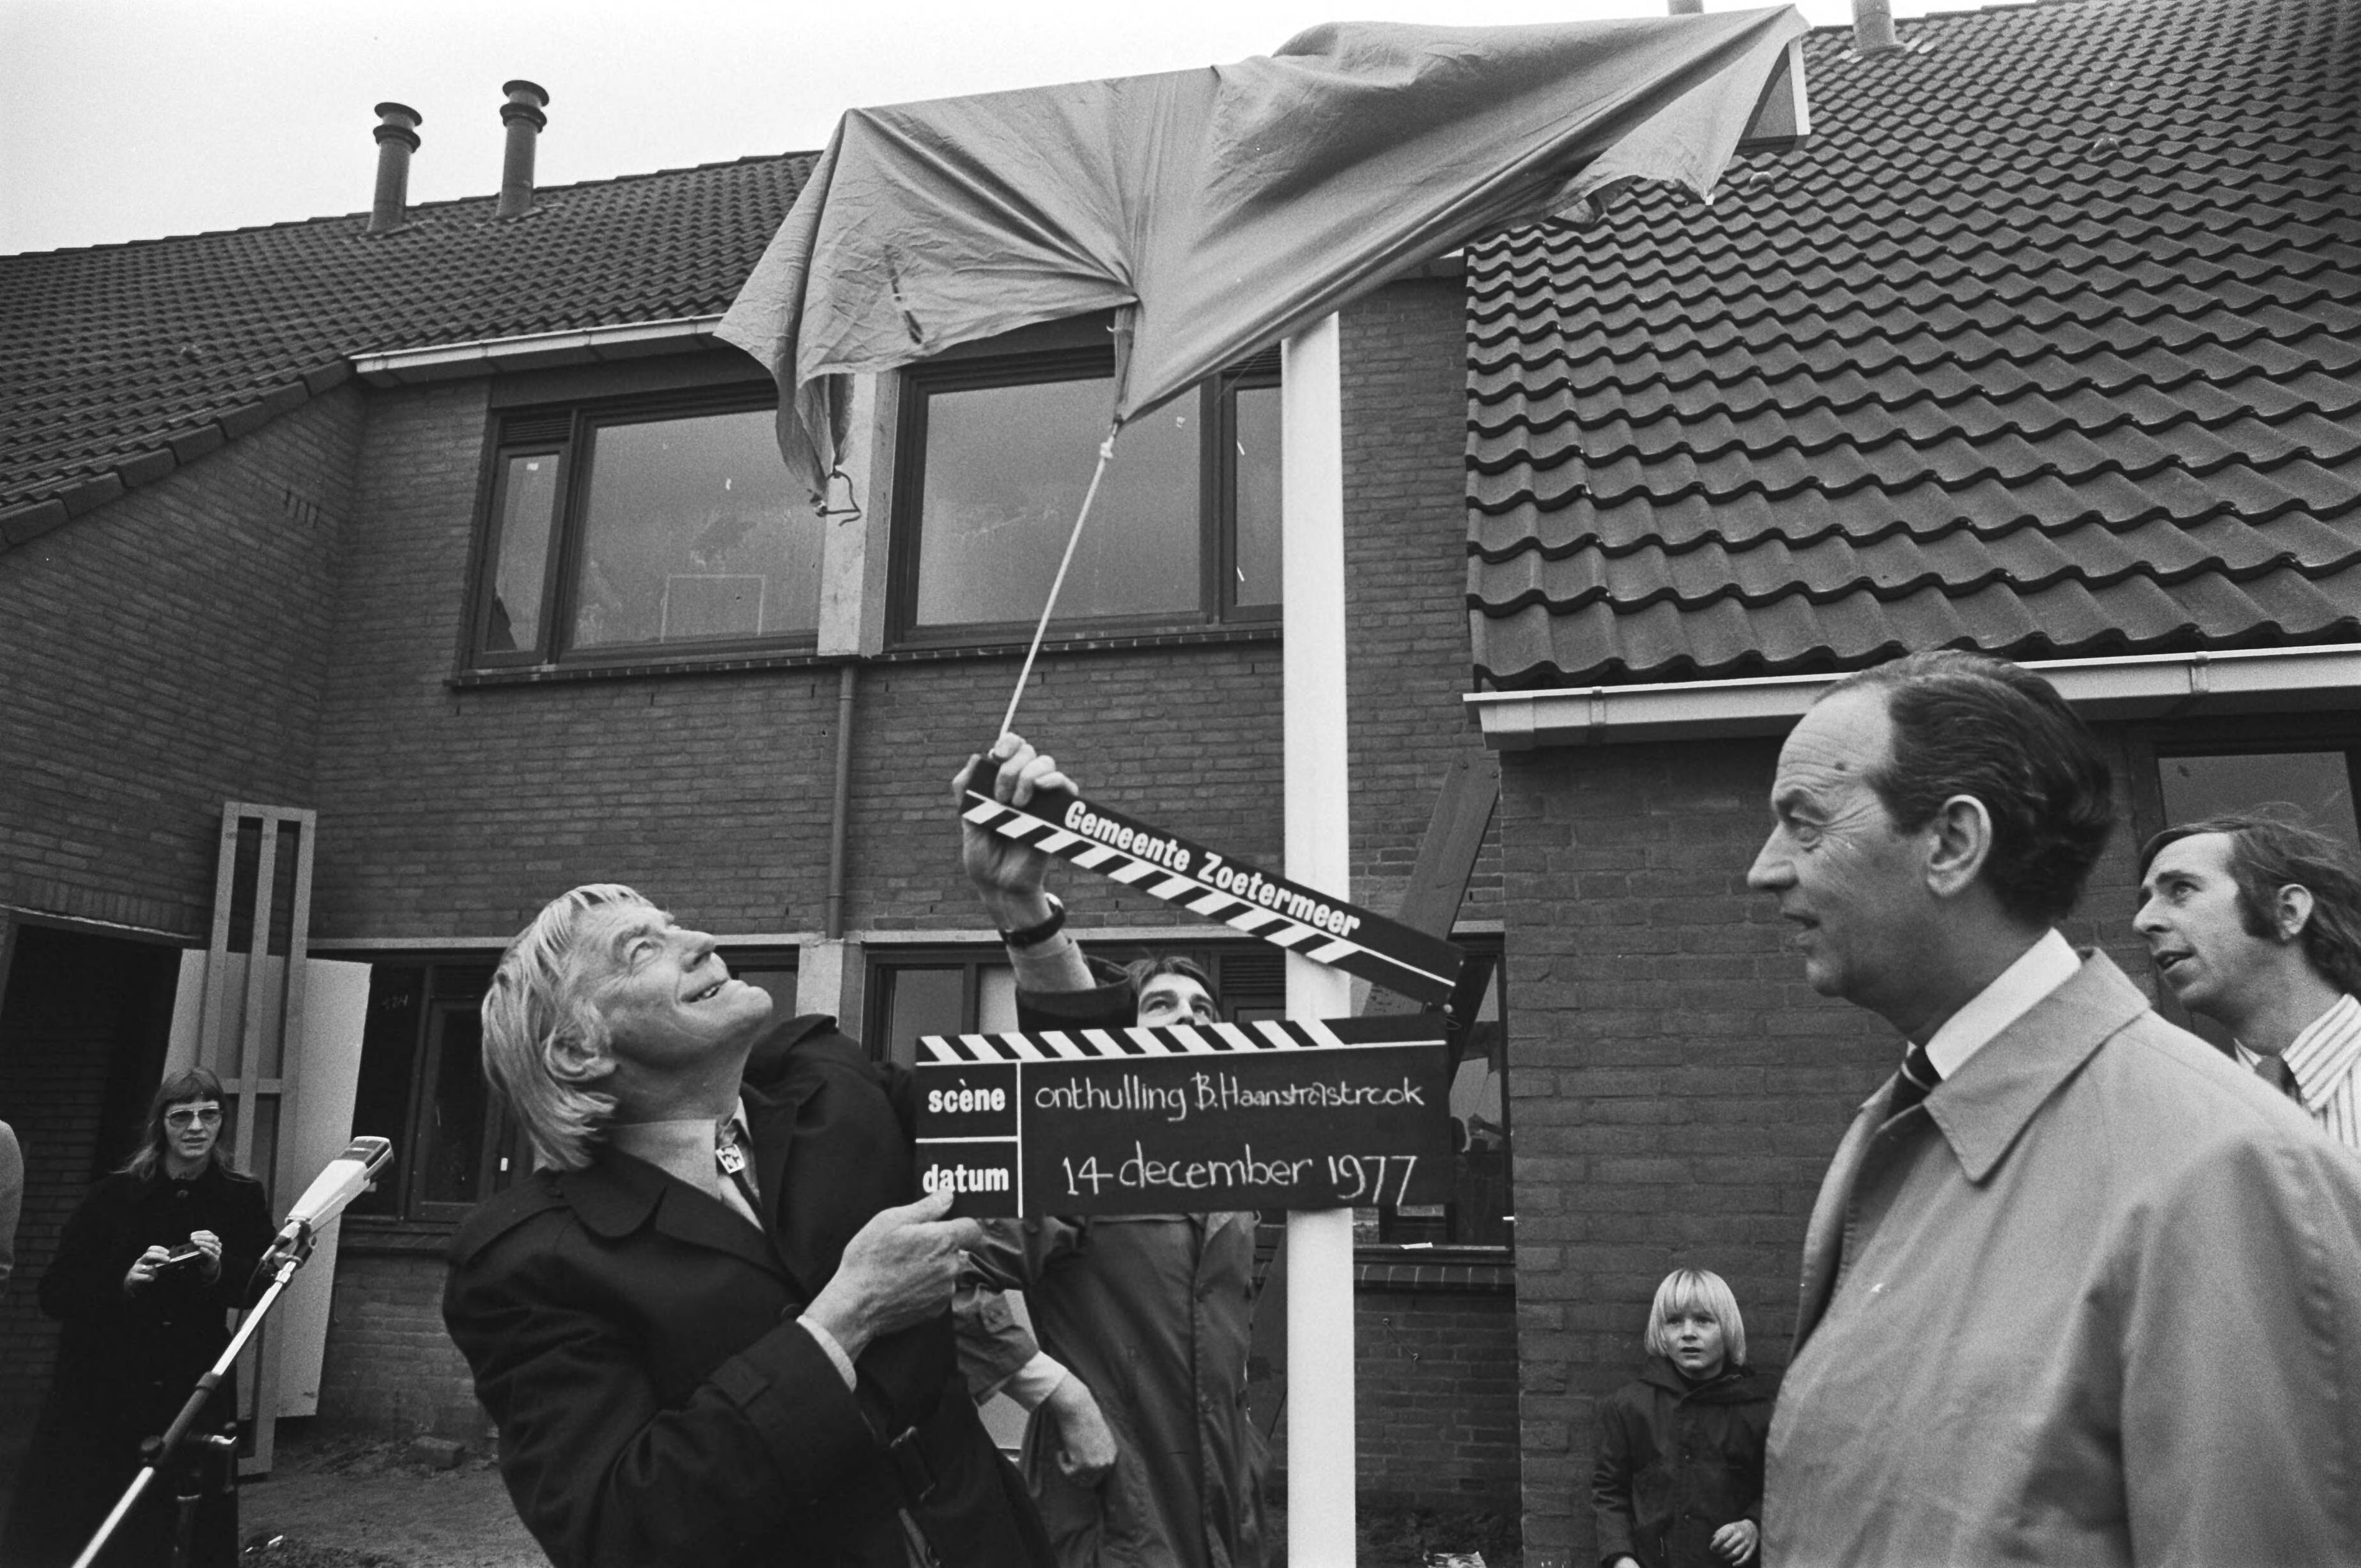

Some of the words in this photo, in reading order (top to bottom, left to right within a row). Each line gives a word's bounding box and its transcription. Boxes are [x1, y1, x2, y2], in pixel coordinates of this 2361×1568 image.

[1064, 800, 1191, 872] Gemeente
[1197, 851, 1361, 937] Zoetermeer
[928, 1078, 1005, 1112] scène
[1035, 1073, 1186, 1122] onthulling
[922, 1164, 1009, 1193] datum
[1063, 1156, 1113, 1194] 14
[1120, 1140, 1313, 1188] december
[1328, 1154, 1417, 1206] 1977
